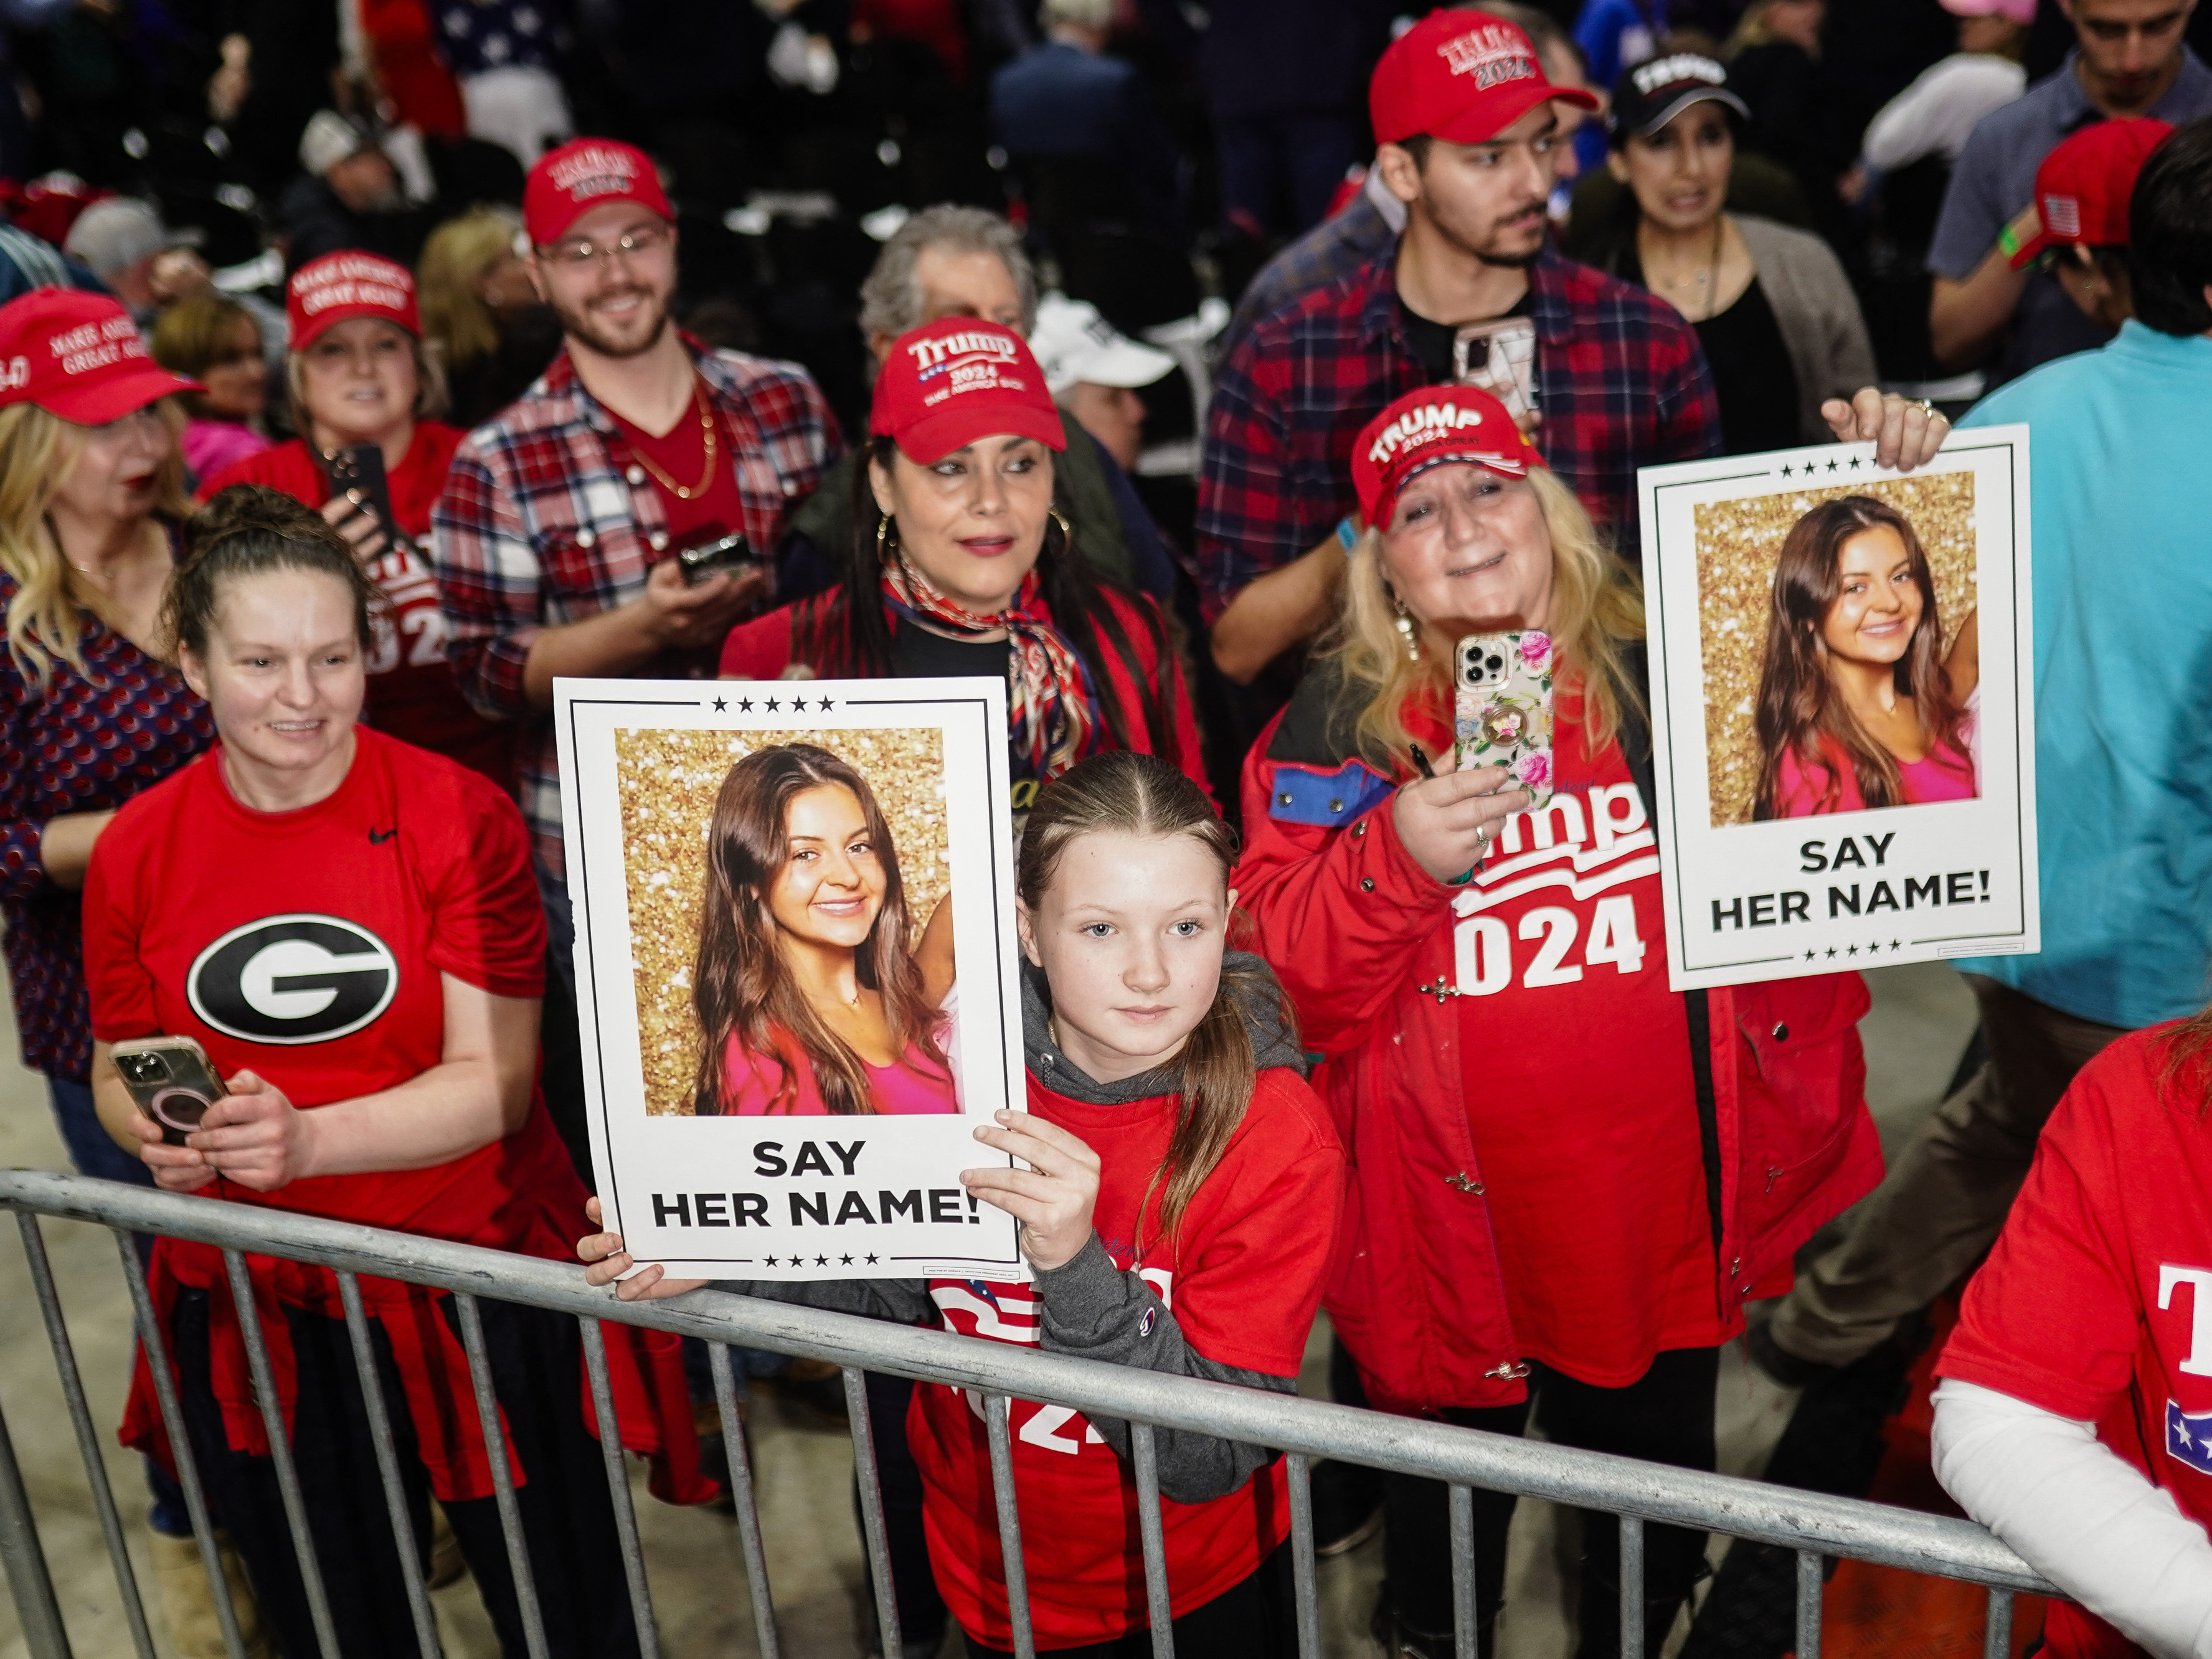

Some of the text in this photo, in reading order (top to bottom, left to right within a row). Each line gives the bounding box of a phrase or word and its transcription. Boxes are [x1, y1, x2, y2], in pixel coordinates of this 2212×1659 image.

[1471, 57, 1536, 91] 2024
[49, 321, 102, 359] MAKE
[907, 331, 1019, 371] Trump
[63, 344, 121, 375] GREAT
[949, 362, 999, 386] 2024
[1368, 402, 1482, 463] TRUMP
[1402, 428, 1449, 454] 2024
[1800, 832, 1896, 873] SAY
[1711, 869, 1990, 933] HER NAME!
[753, 1140, 866, 1177] SAY
[651, 1188, 981, 1227] HER NAME!
